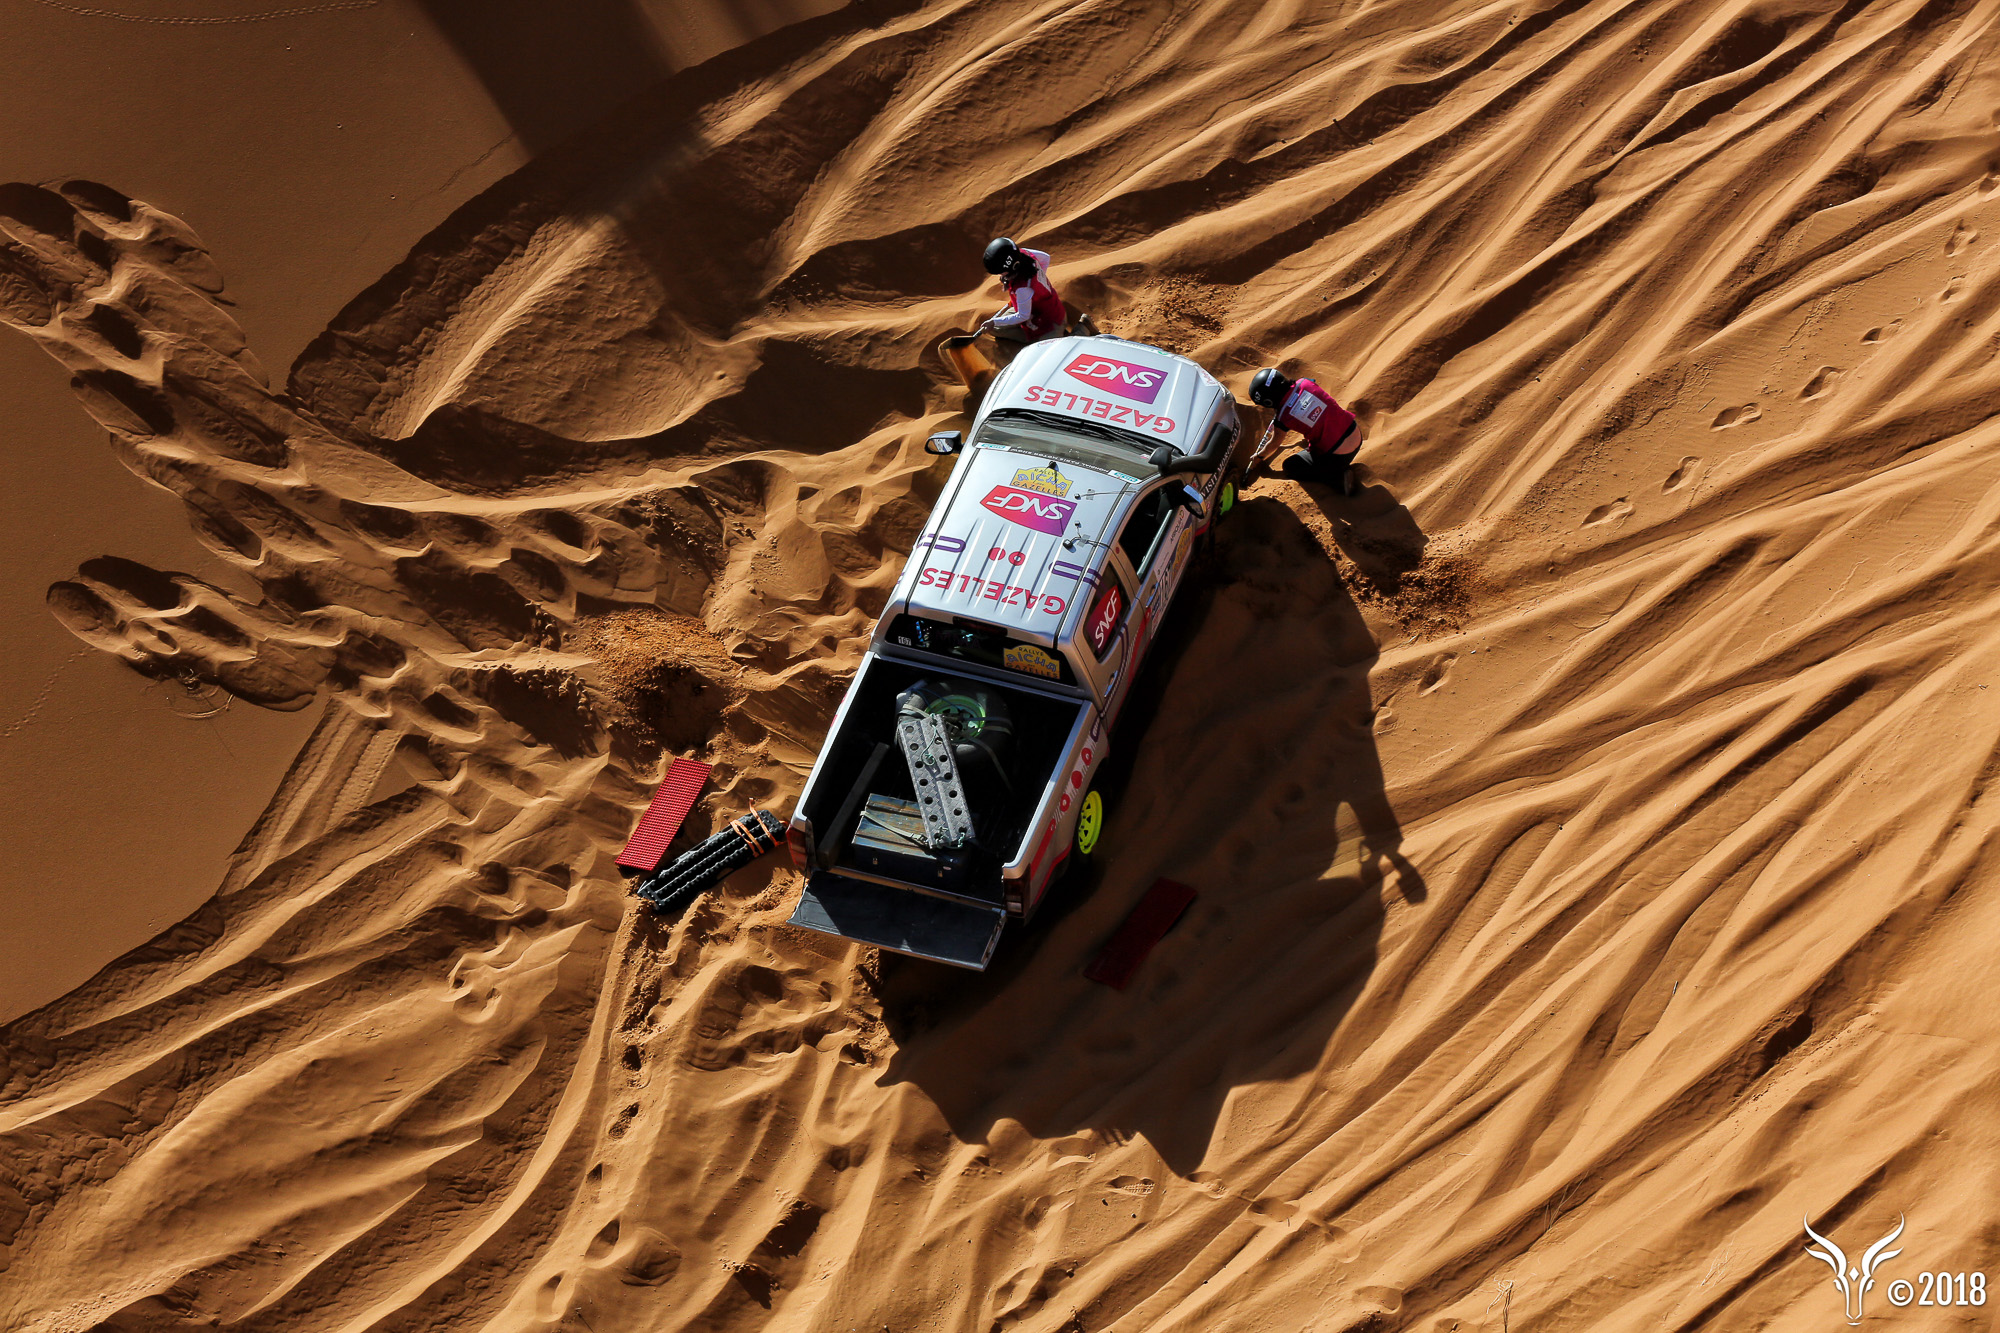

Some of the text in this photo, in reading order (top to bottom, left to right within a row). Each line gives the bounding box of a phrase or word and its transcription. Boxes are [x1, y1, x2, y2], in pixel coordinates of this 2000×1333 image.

[1003, 255, 1013, 268] 167
[1070, 361, 1162, 388] SNCF
[1023, 386, 1176, 434] GAZELLES
[1012, 481, 1065, 496] GAZELLES
[1201, 472, 1218, 497] VISIT
[986, 492, 1072, 520] SNCF
[919, 568, 1066, 615] GAZELLES
[1095, 589, 1118, 649] SNCF
[1018, 647, 1049, 656] RALLYE
[1006, 662, 1058, 678] GAZELLES
